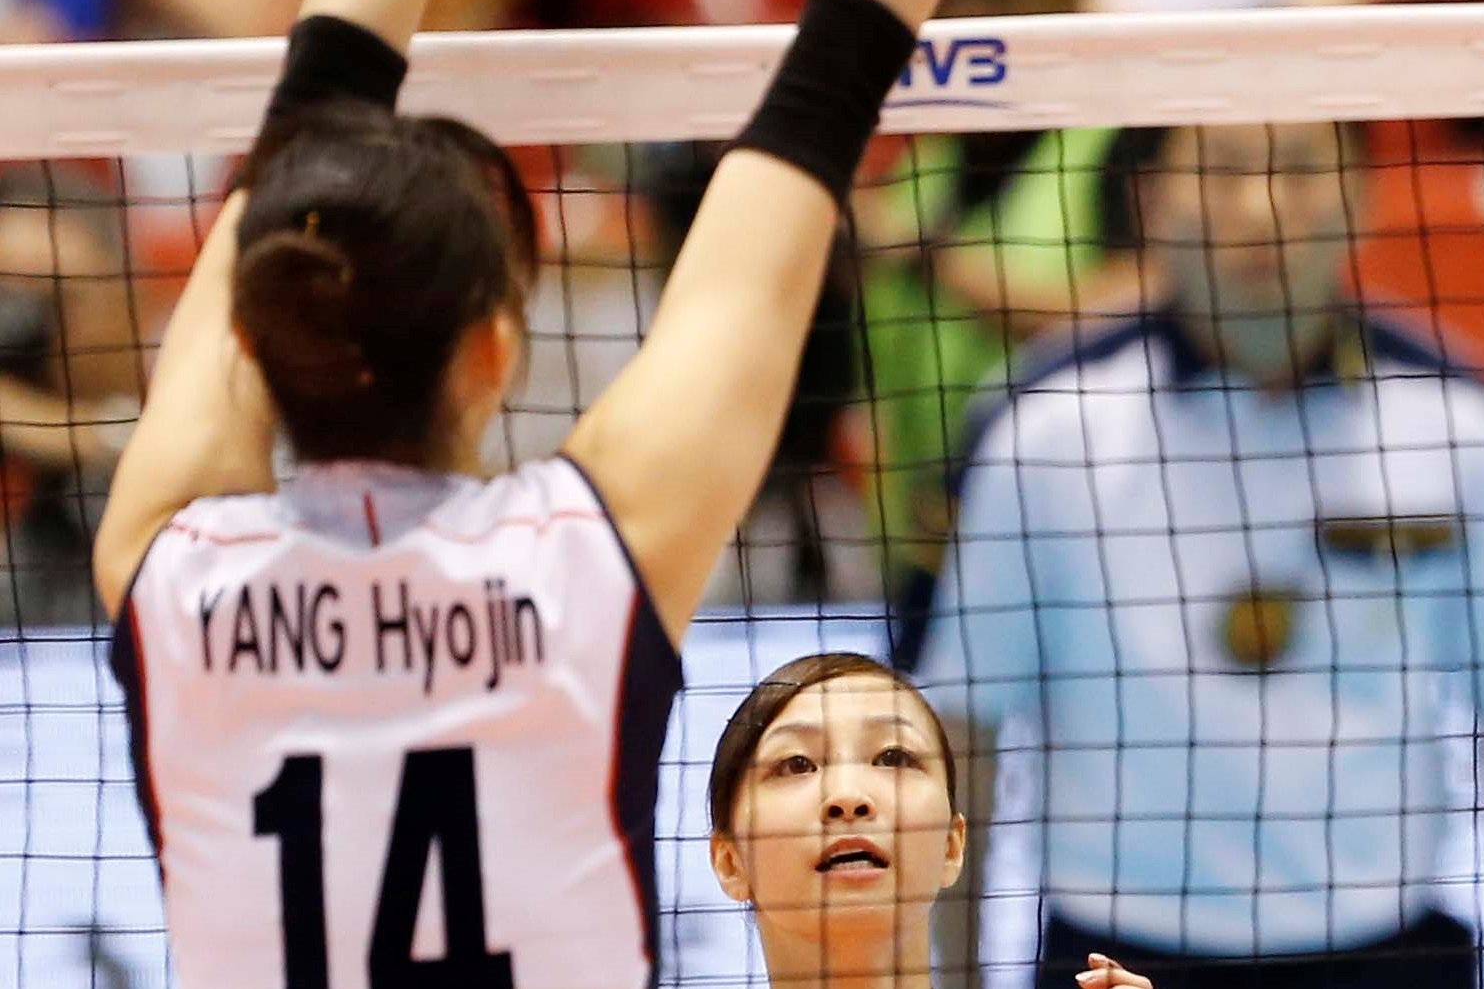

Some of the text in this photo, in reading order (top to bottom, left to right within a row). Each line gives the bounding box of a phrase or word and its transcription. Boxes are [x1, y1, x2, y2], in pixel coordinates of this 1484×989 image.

[899, 37, 1008, 86] IVB
[198, 578, 544, 695] YANG Hyojin
[252, 746, 517, 989] 14
